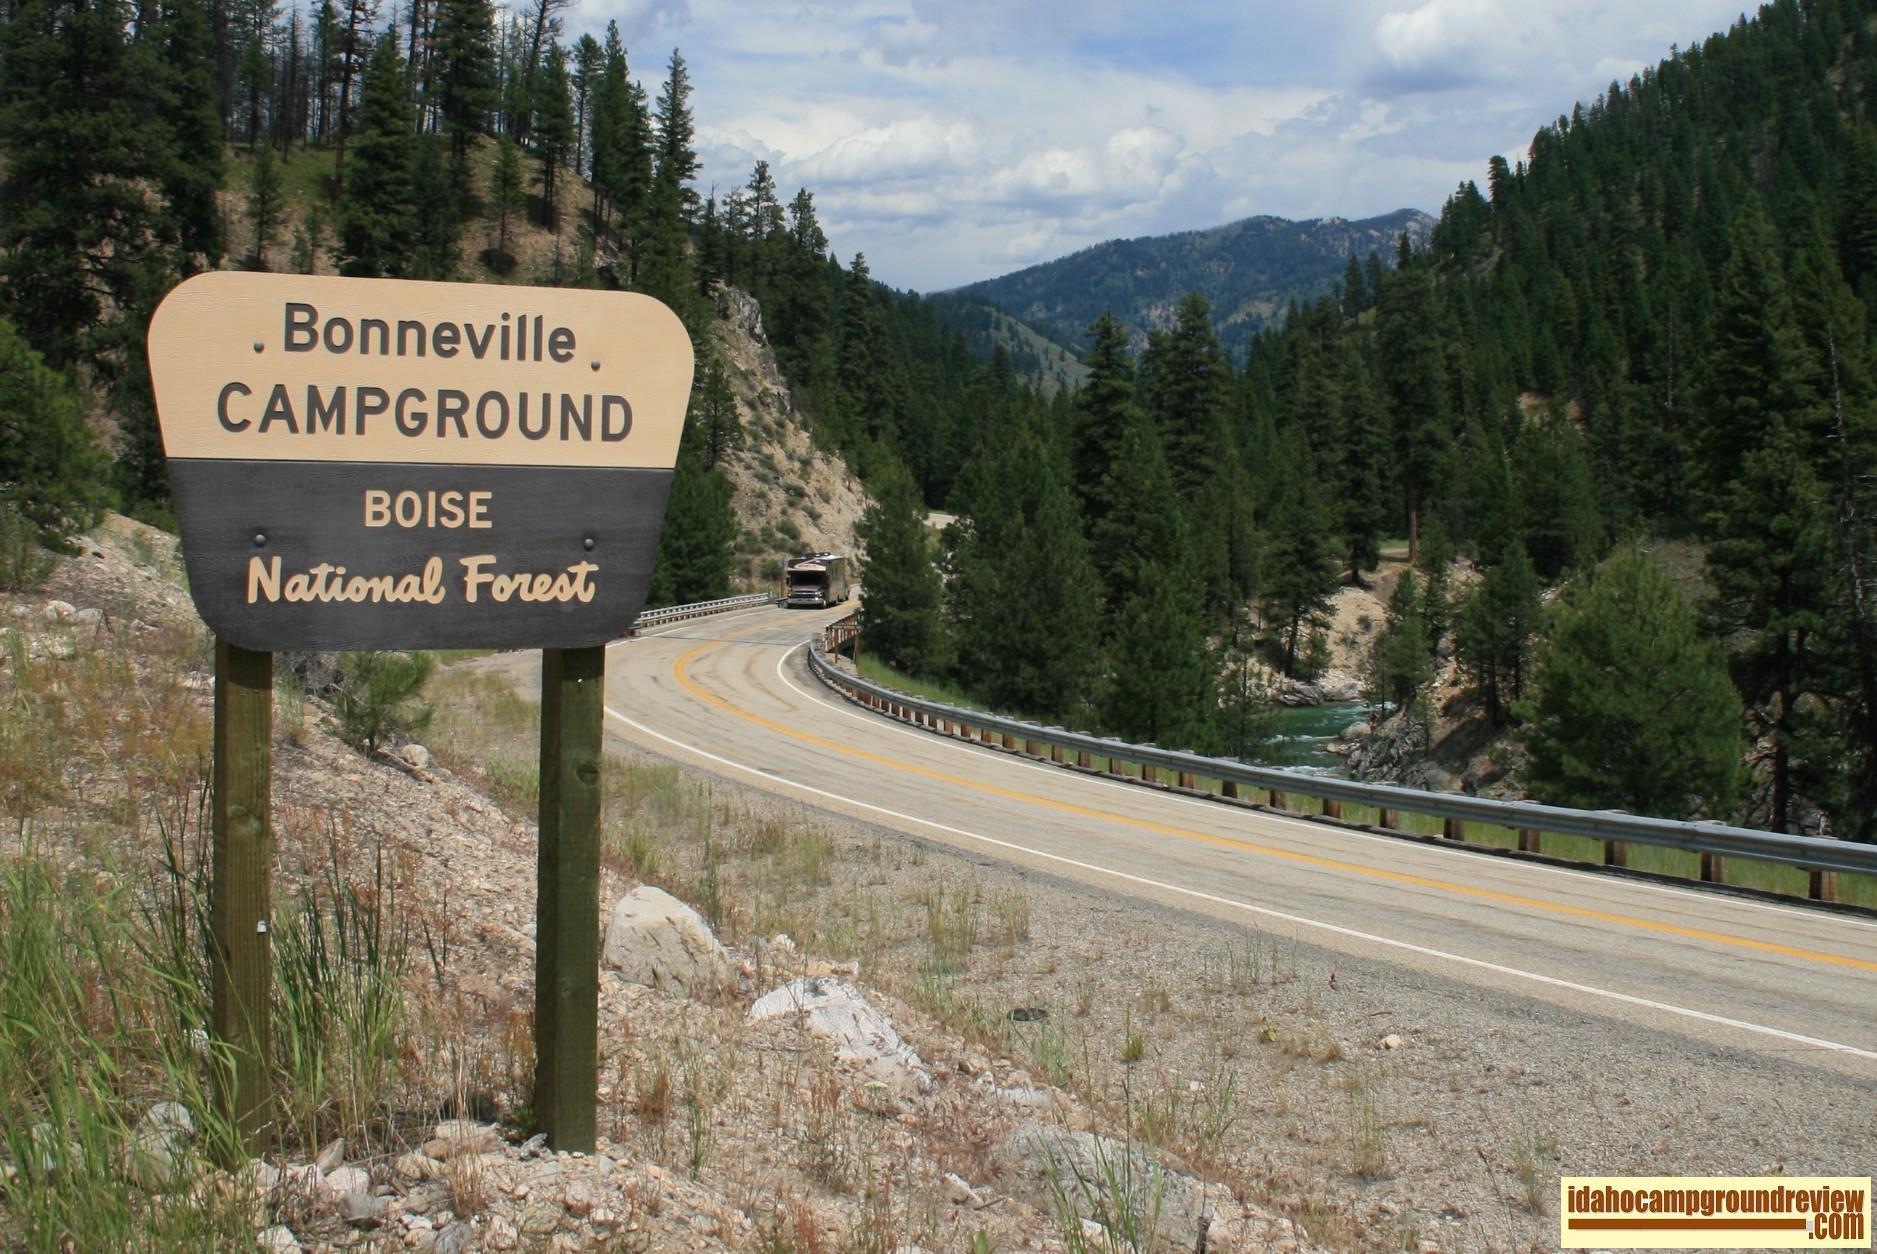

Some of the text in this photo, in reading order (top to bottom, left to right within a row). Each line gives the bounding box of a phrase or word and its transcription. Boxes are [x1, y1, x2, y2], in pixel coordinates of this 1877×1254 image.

[284, 302, 577, 363] Bonneville
[217, 381, 633, 443] CAMPGROUND
[363, 490, 493, 528] BOISE
[247, 555, 599, 604] National Forest
